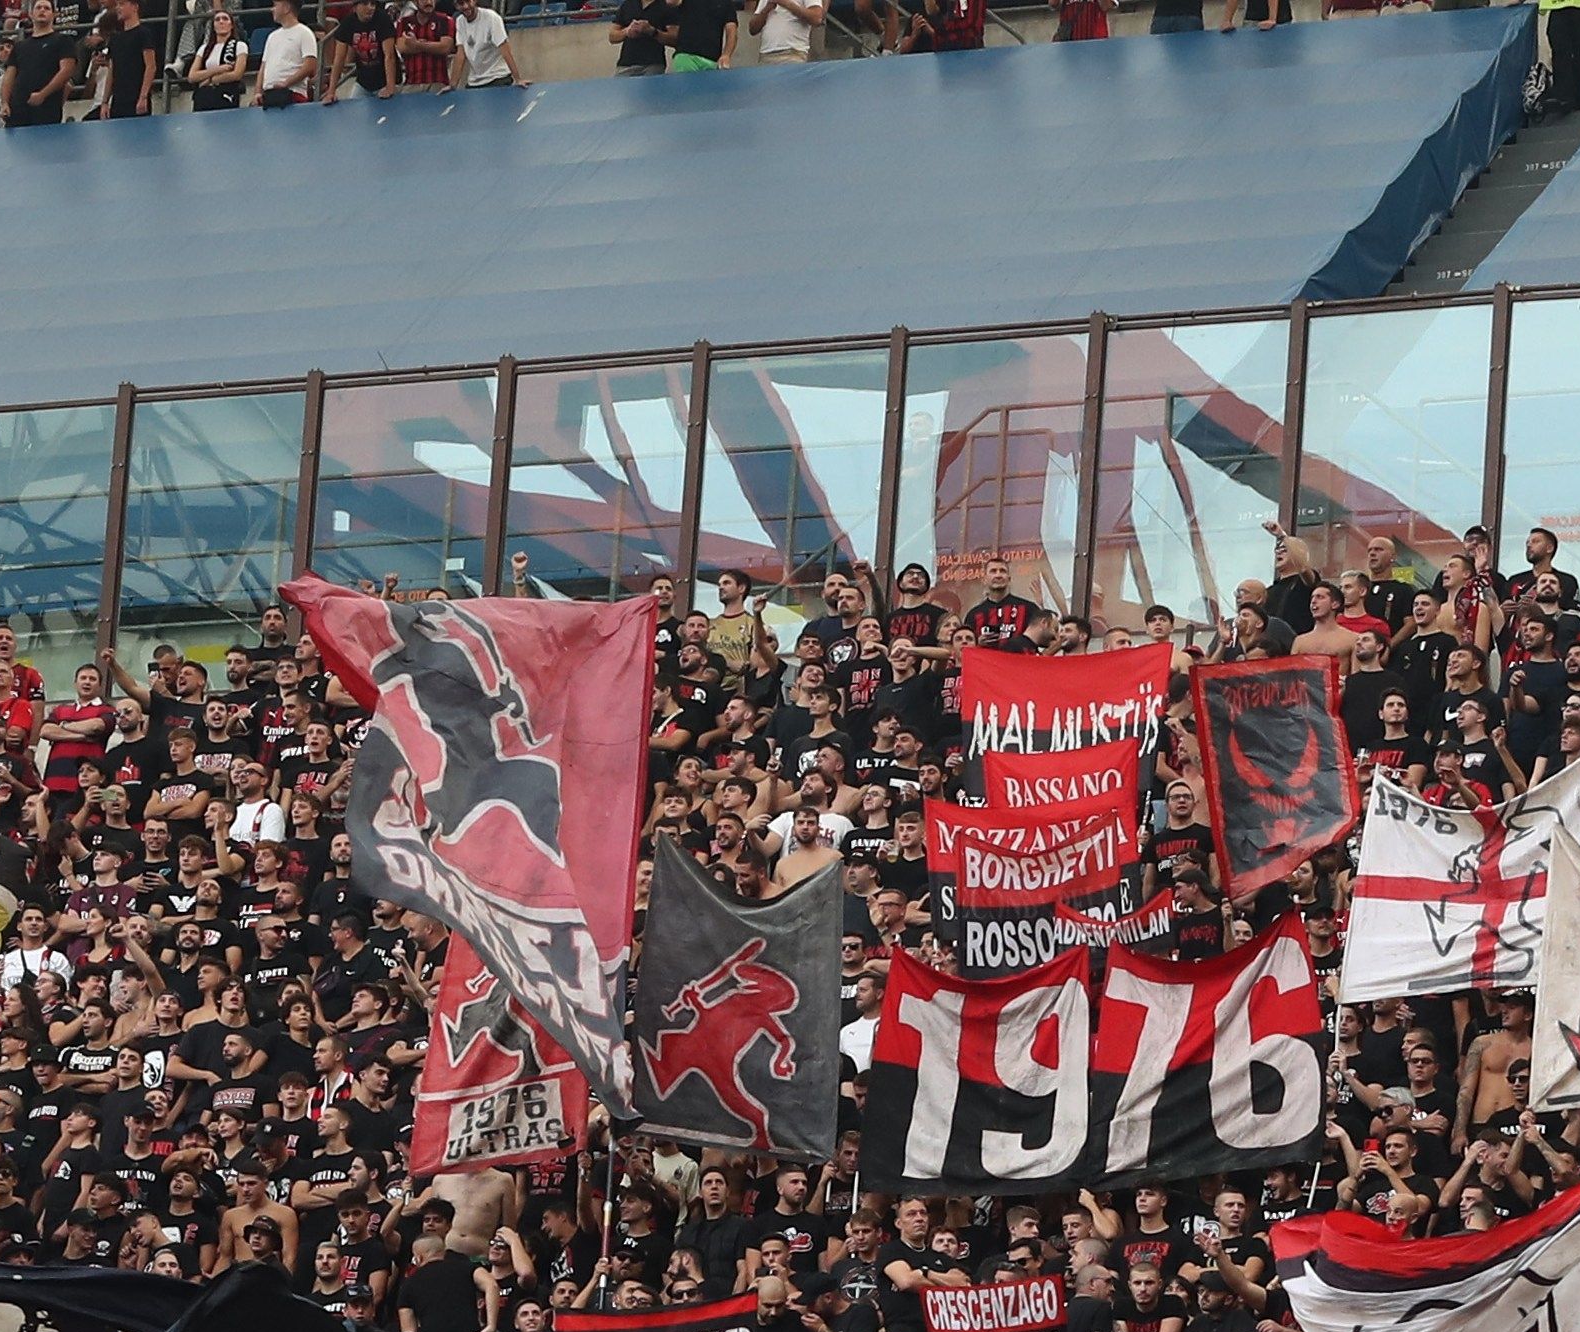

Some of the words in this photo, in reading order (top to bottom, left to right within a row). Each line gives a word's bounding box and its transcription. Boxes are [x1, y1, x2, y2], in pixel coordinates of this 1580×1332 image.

[964, 826, 1117, 892] BORGHETTI
[244, 967, 289, 982] BNDITI
[898, 936, 1322, 1180] 1976
[460, 1083, 549, 1132] 1976
[447, 1118, 563, 1161] ULTRAS
[925, 1281, 1059, 1332] CRESCENZAGO
